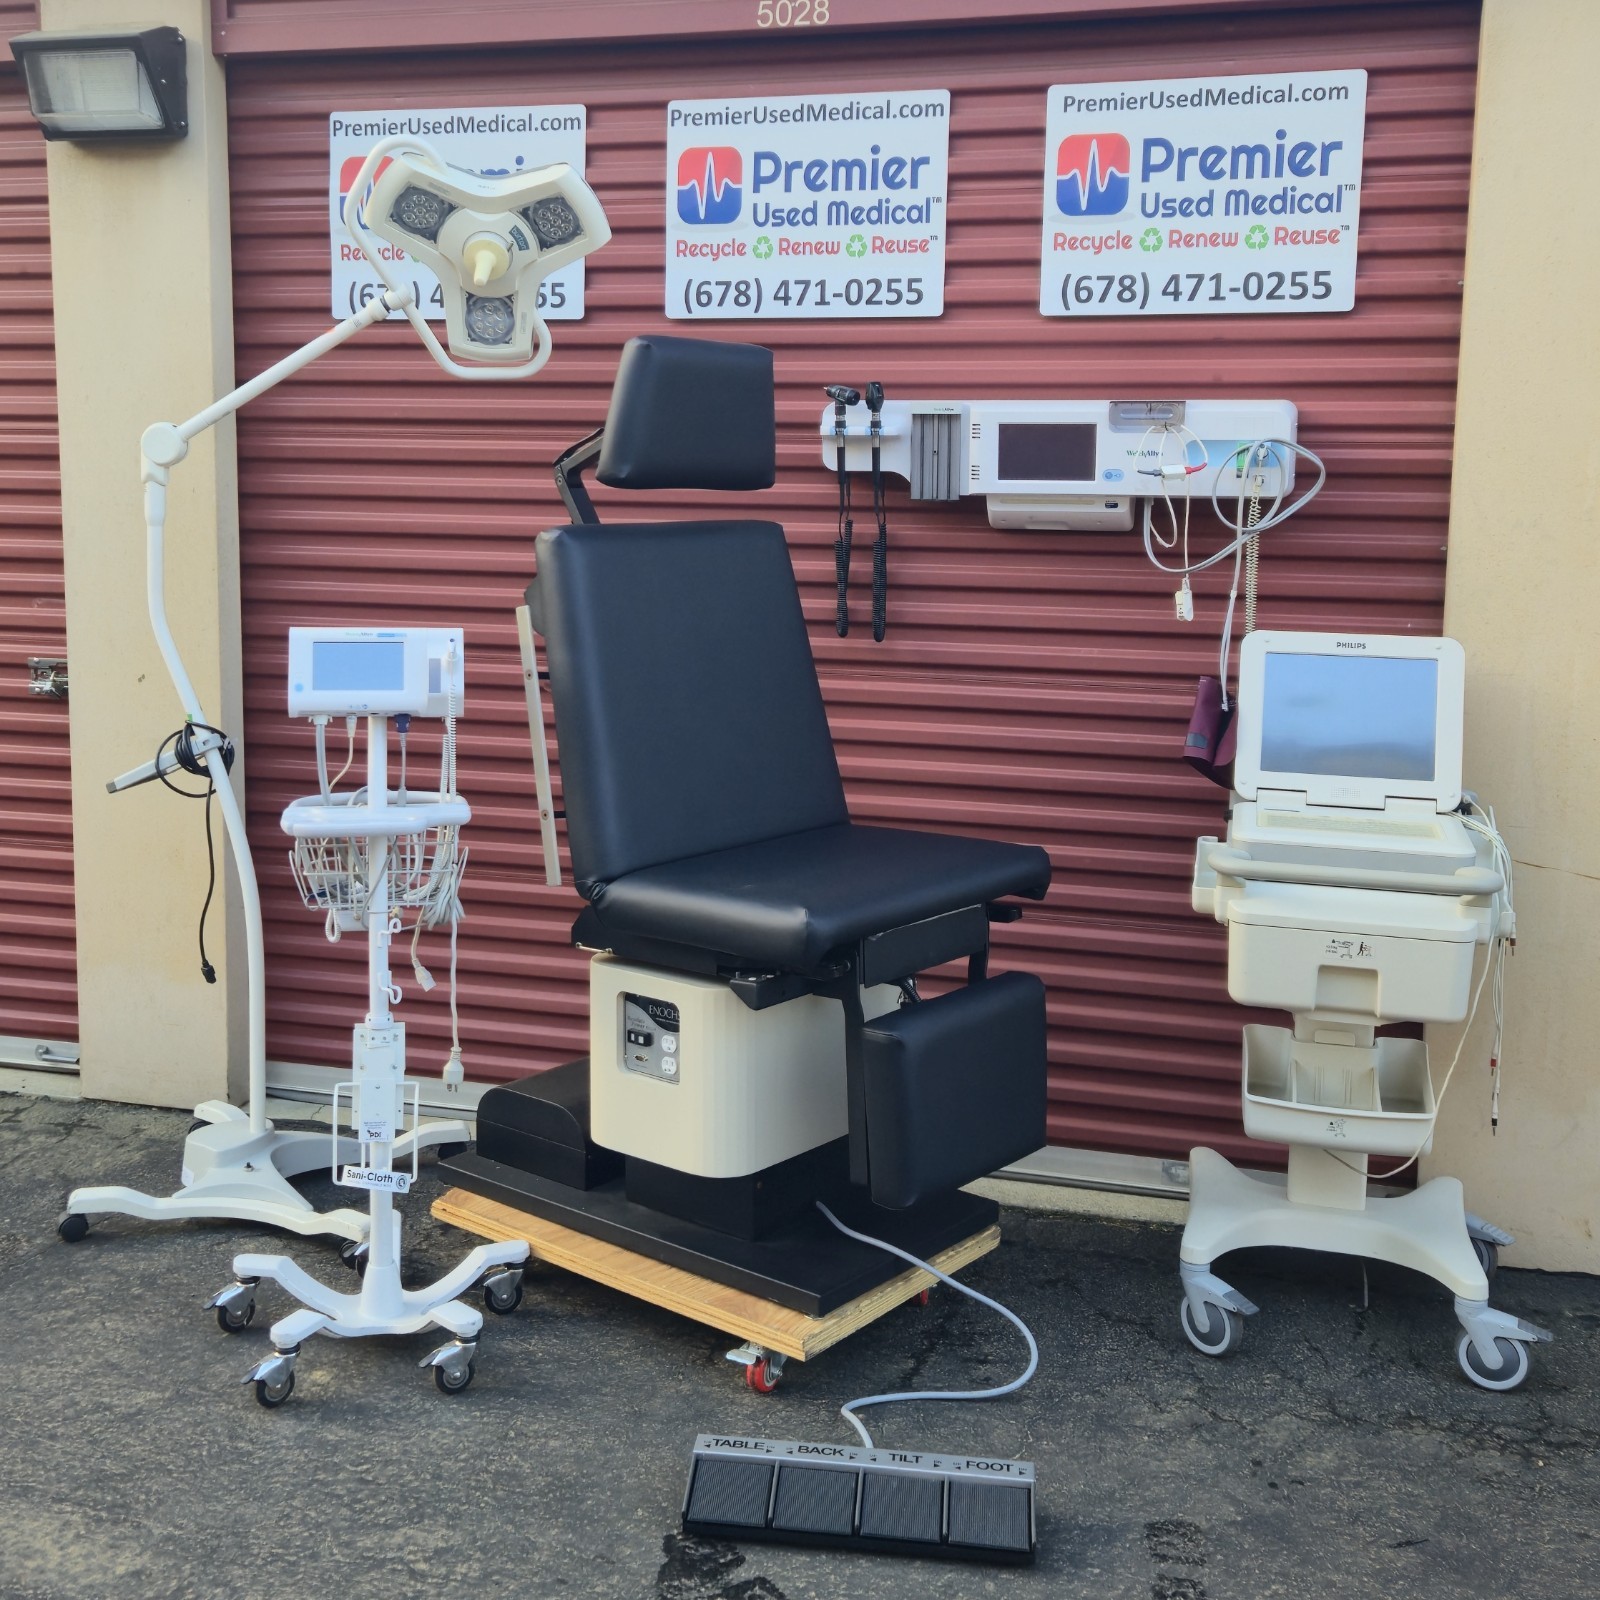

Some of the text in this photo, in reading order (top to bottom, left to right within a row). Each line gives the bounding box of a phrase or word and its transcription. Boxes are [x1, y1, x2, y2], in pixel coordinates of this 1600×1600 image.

[757, 0, 829, 27] 5028
[1063, 83, 1349, 113] PremierUsedMedical.com
[332, 113, 582, 137] PremierUsedMedical.com
[670, 100, 945, 127] PremierUsedMedical.com
[753, 144, 931, 194] Premier
[1141, 128, 1343, 183] Premier
[753, 200, 818, 228] Used
[1140, 189, 1214, 219] Used
[676, 238, 747, 261] Recycle
[778, 237, 841, 256] Renew
[1053, 230, 1133, 255] Recycle
[1168, 229, 1239, 249] Renew
[684, 277, 924, 314] (678) 471-0255
[1061, 270, 1333, 310] (678) 471-0255
[1336, 641, 1367, 650] PHILIPS
[346, 1169, 393, 1183] Sani-Cloth
[712, 1438, 765, 1450] TABLE
[797, 1445, 844, 1457] BACK
[889, 1453, 923, 1464] TILT
[966, 1460, 1014, 1472] FOOT
